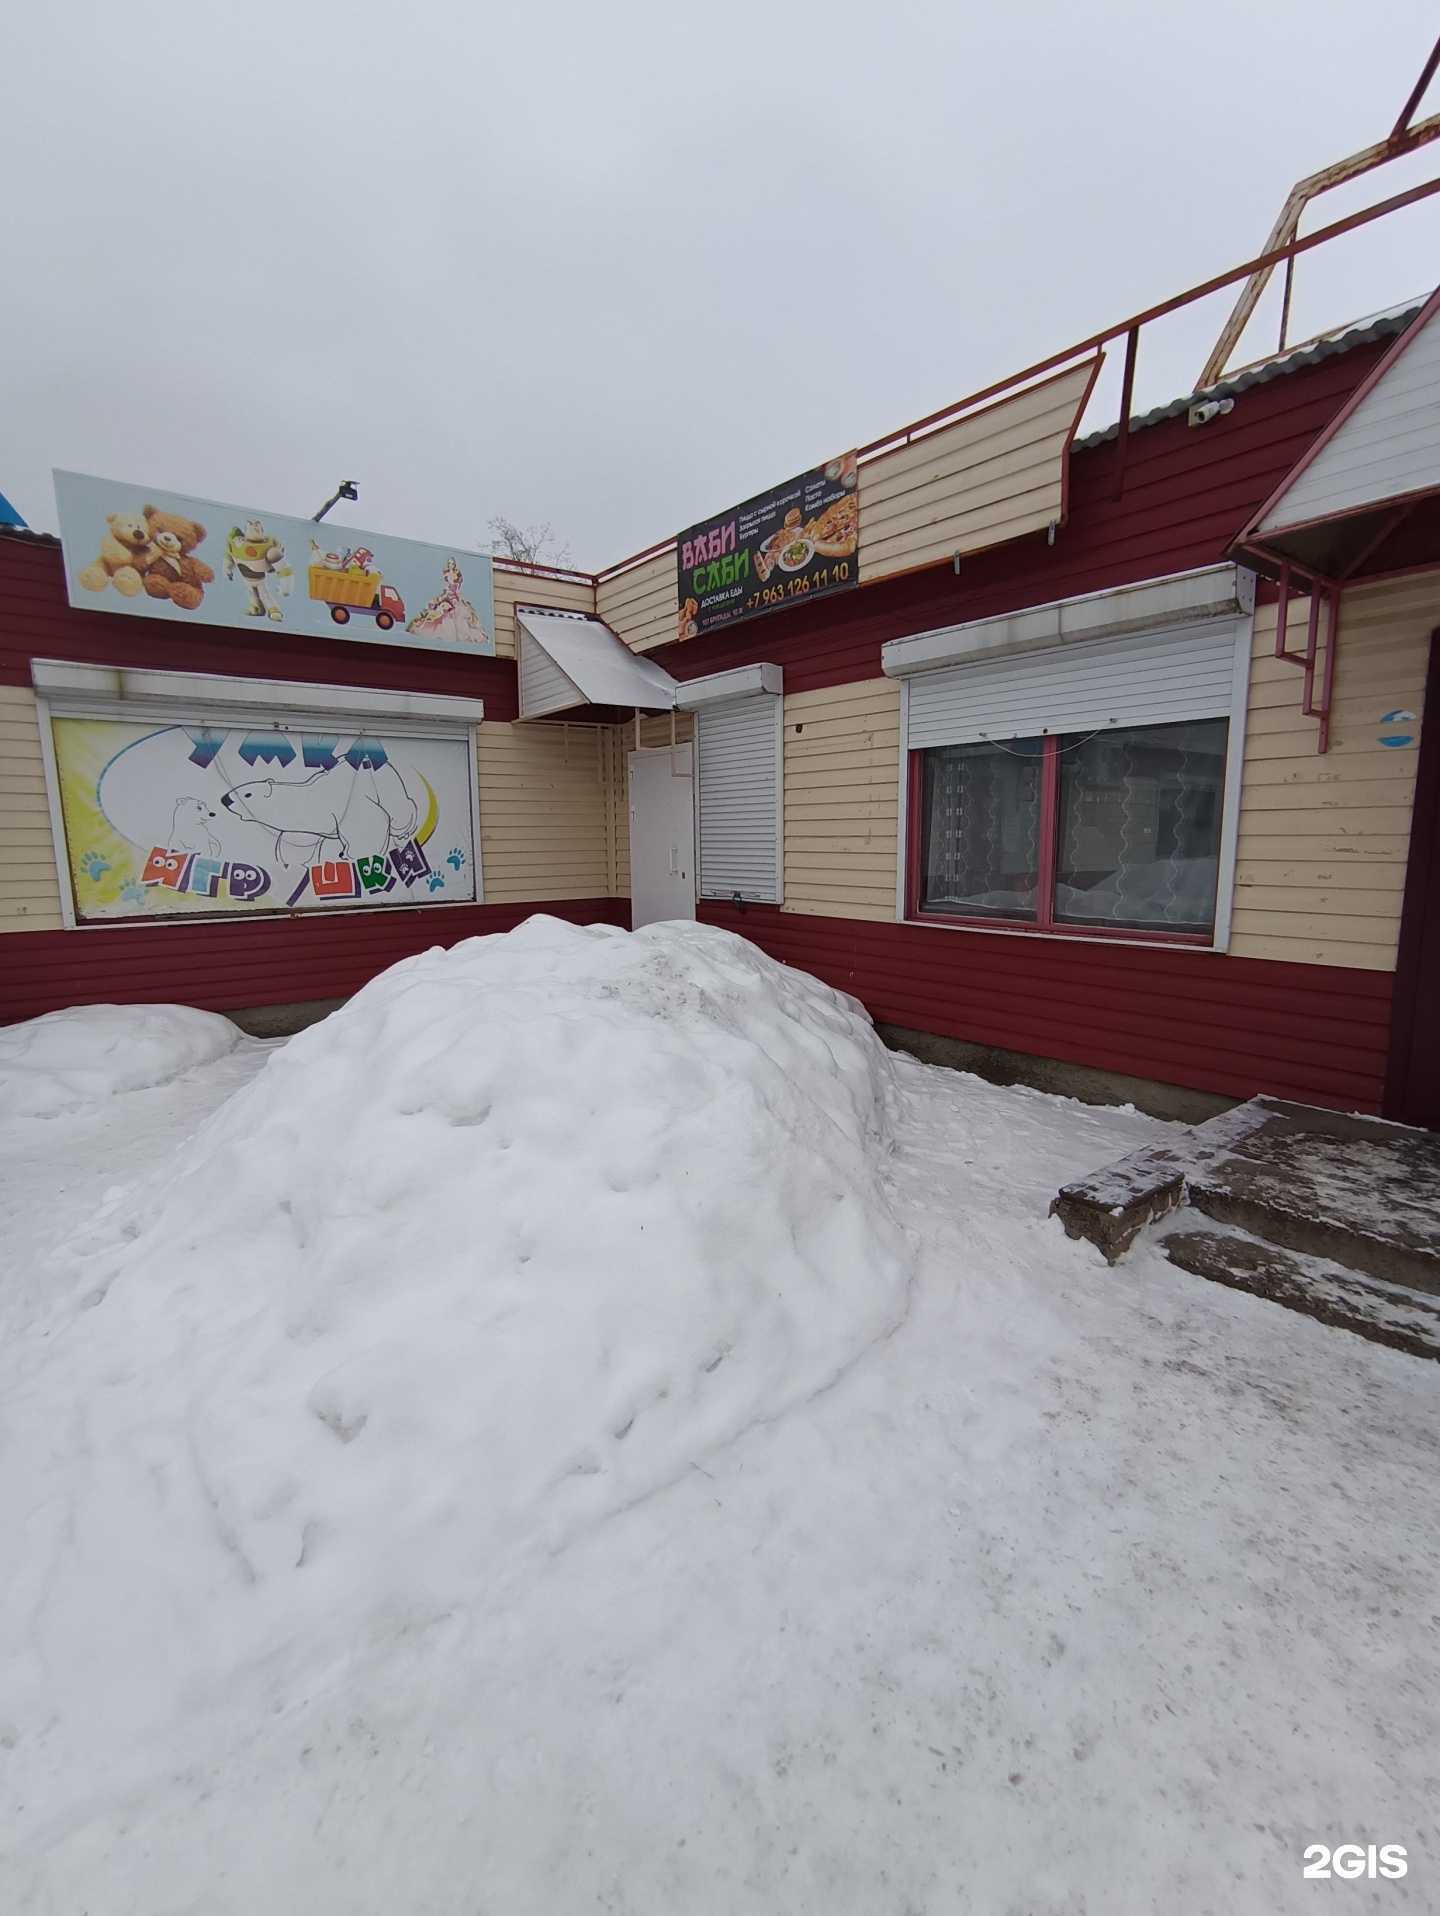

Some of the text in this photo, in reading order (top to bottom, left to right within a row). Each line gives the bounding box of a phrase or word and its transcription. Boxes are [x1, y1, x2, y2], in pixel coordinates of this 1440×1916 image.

[682, 520, 735, 571] ВАБИ
[692, 548, 749, 594] САБИ
[746, 592, 760, 609] +7
[763, 584, 785, 604] 963
[787, 576, 810, 597] 126
[813, 568, 828, 589] 11
[832, 562, 849, 582] 10
[700, 590, 730, 609] ДОСТАВКА
[730, 586, 743, 599] ЕДЫ
